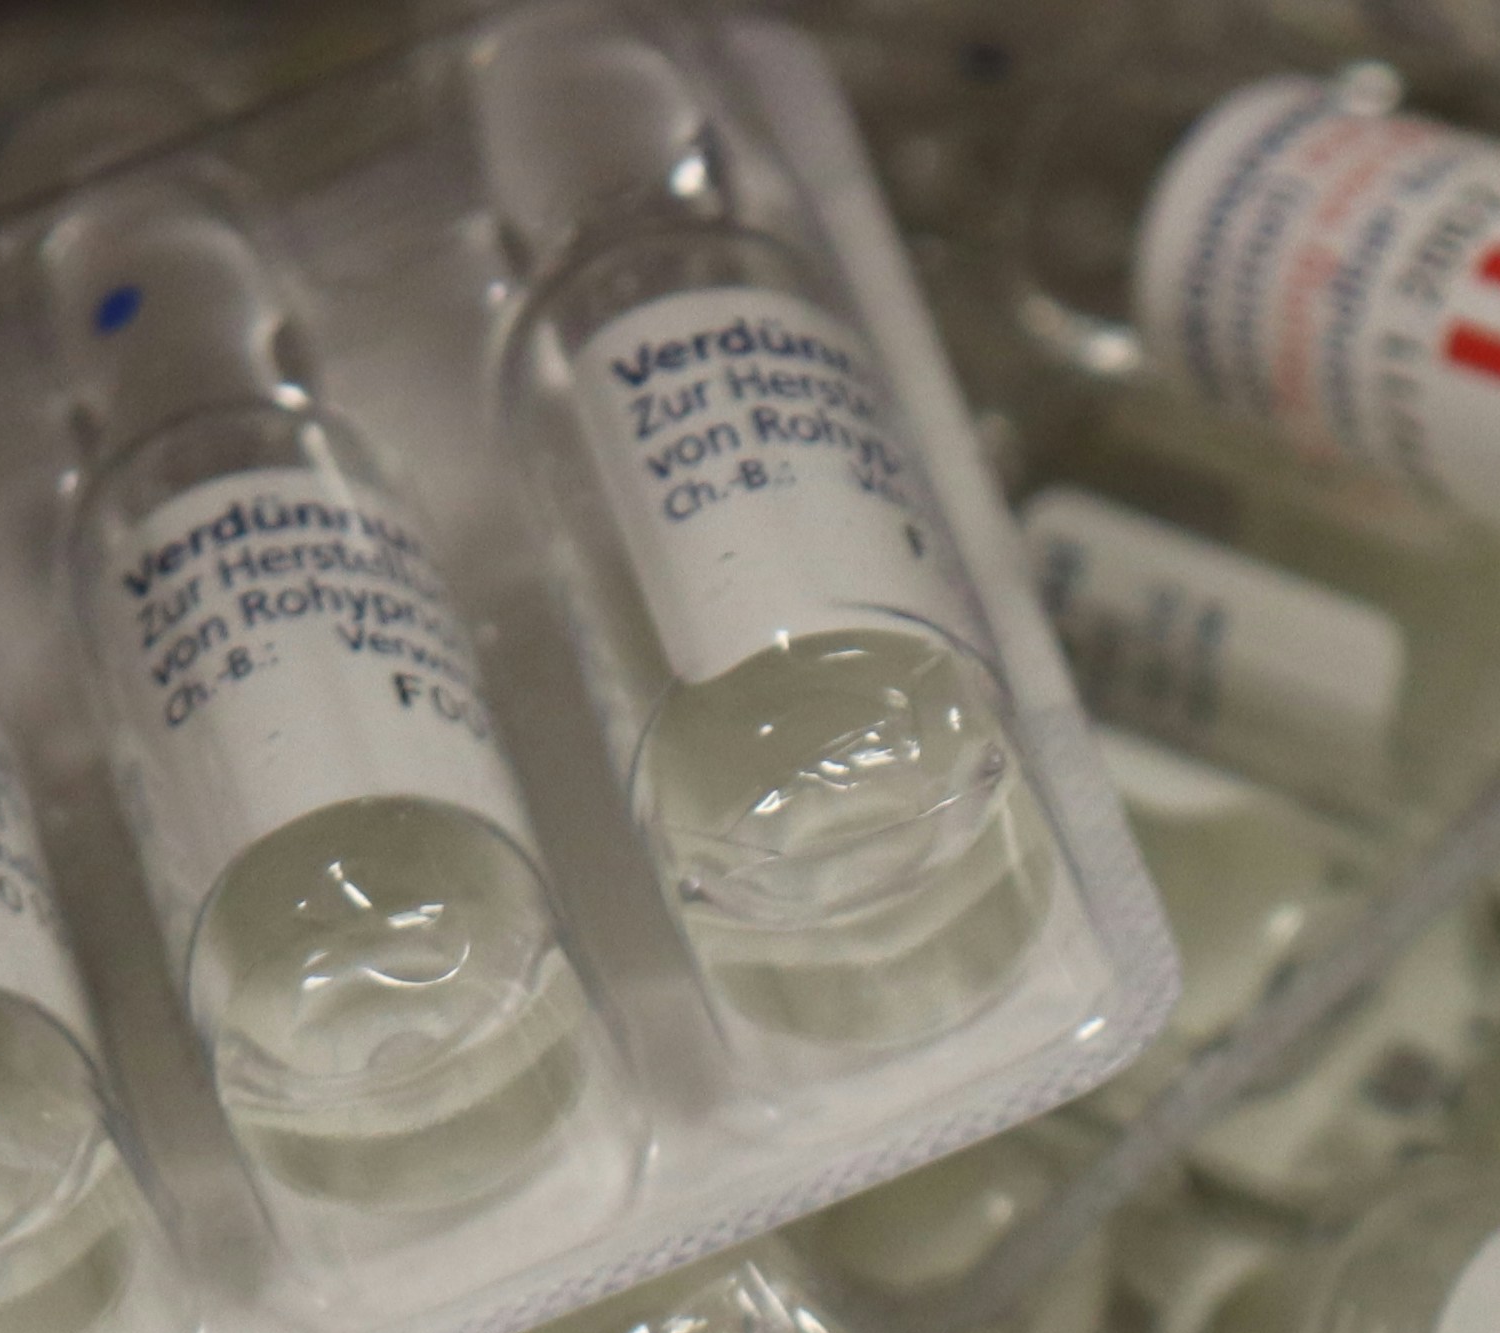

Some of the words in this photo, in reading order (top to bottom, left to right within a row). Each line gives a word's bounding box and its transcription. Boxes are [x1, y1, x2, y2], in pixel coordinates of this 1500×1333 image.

[632, 378, 711, 439] Zur
[646, 420, 740, 480] von
[139, 575, 202, 649] Zur
[153, 617, 229, 686] von
